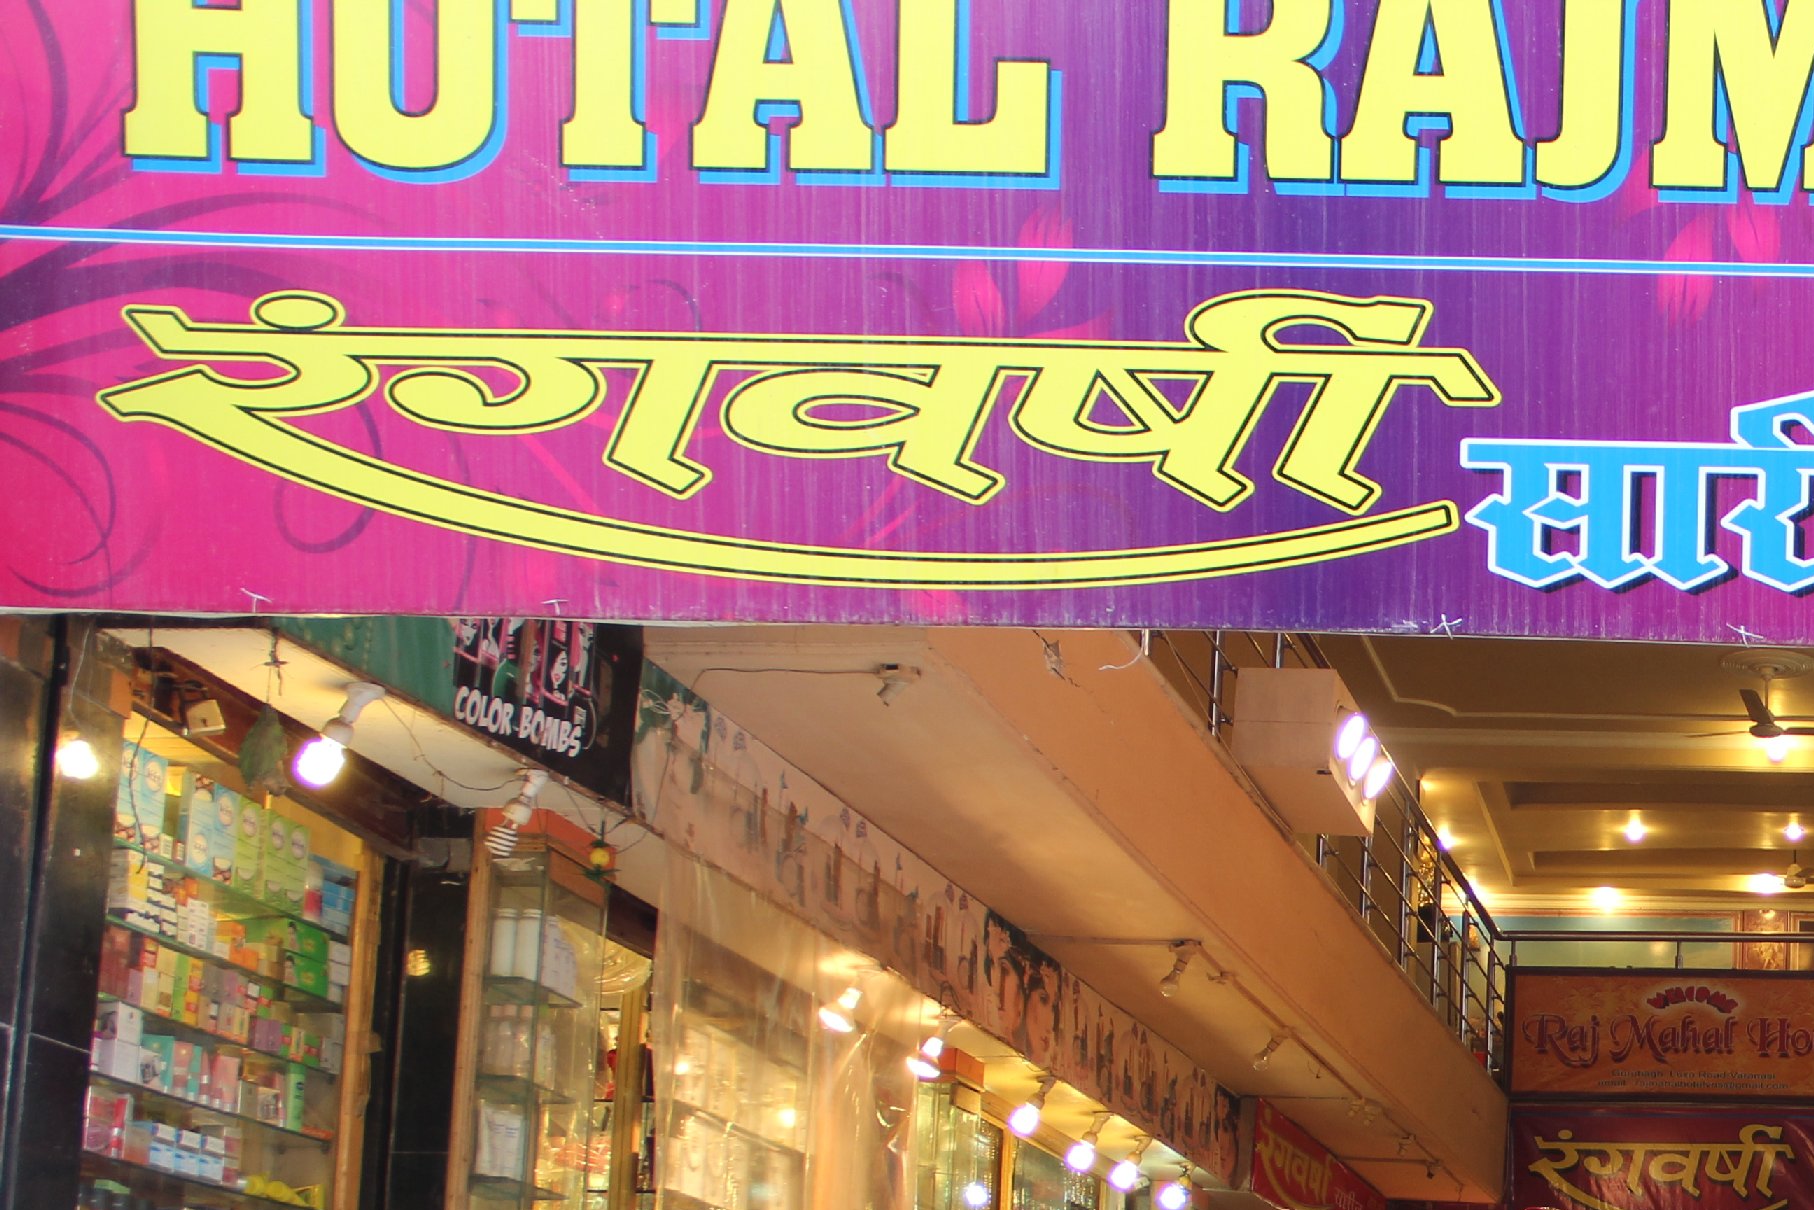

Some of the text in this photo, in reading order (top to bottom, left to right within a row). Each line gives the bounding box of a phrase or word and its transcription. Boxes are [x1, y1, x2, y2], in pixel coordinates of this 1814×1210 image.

[454, 685, 514, 736] COLOR
[517, 704, 583, 758] BOMBS
[1522, 1014, 1600, 1069] Raj
[1608, 1014, 1735, 1063] Mahal
